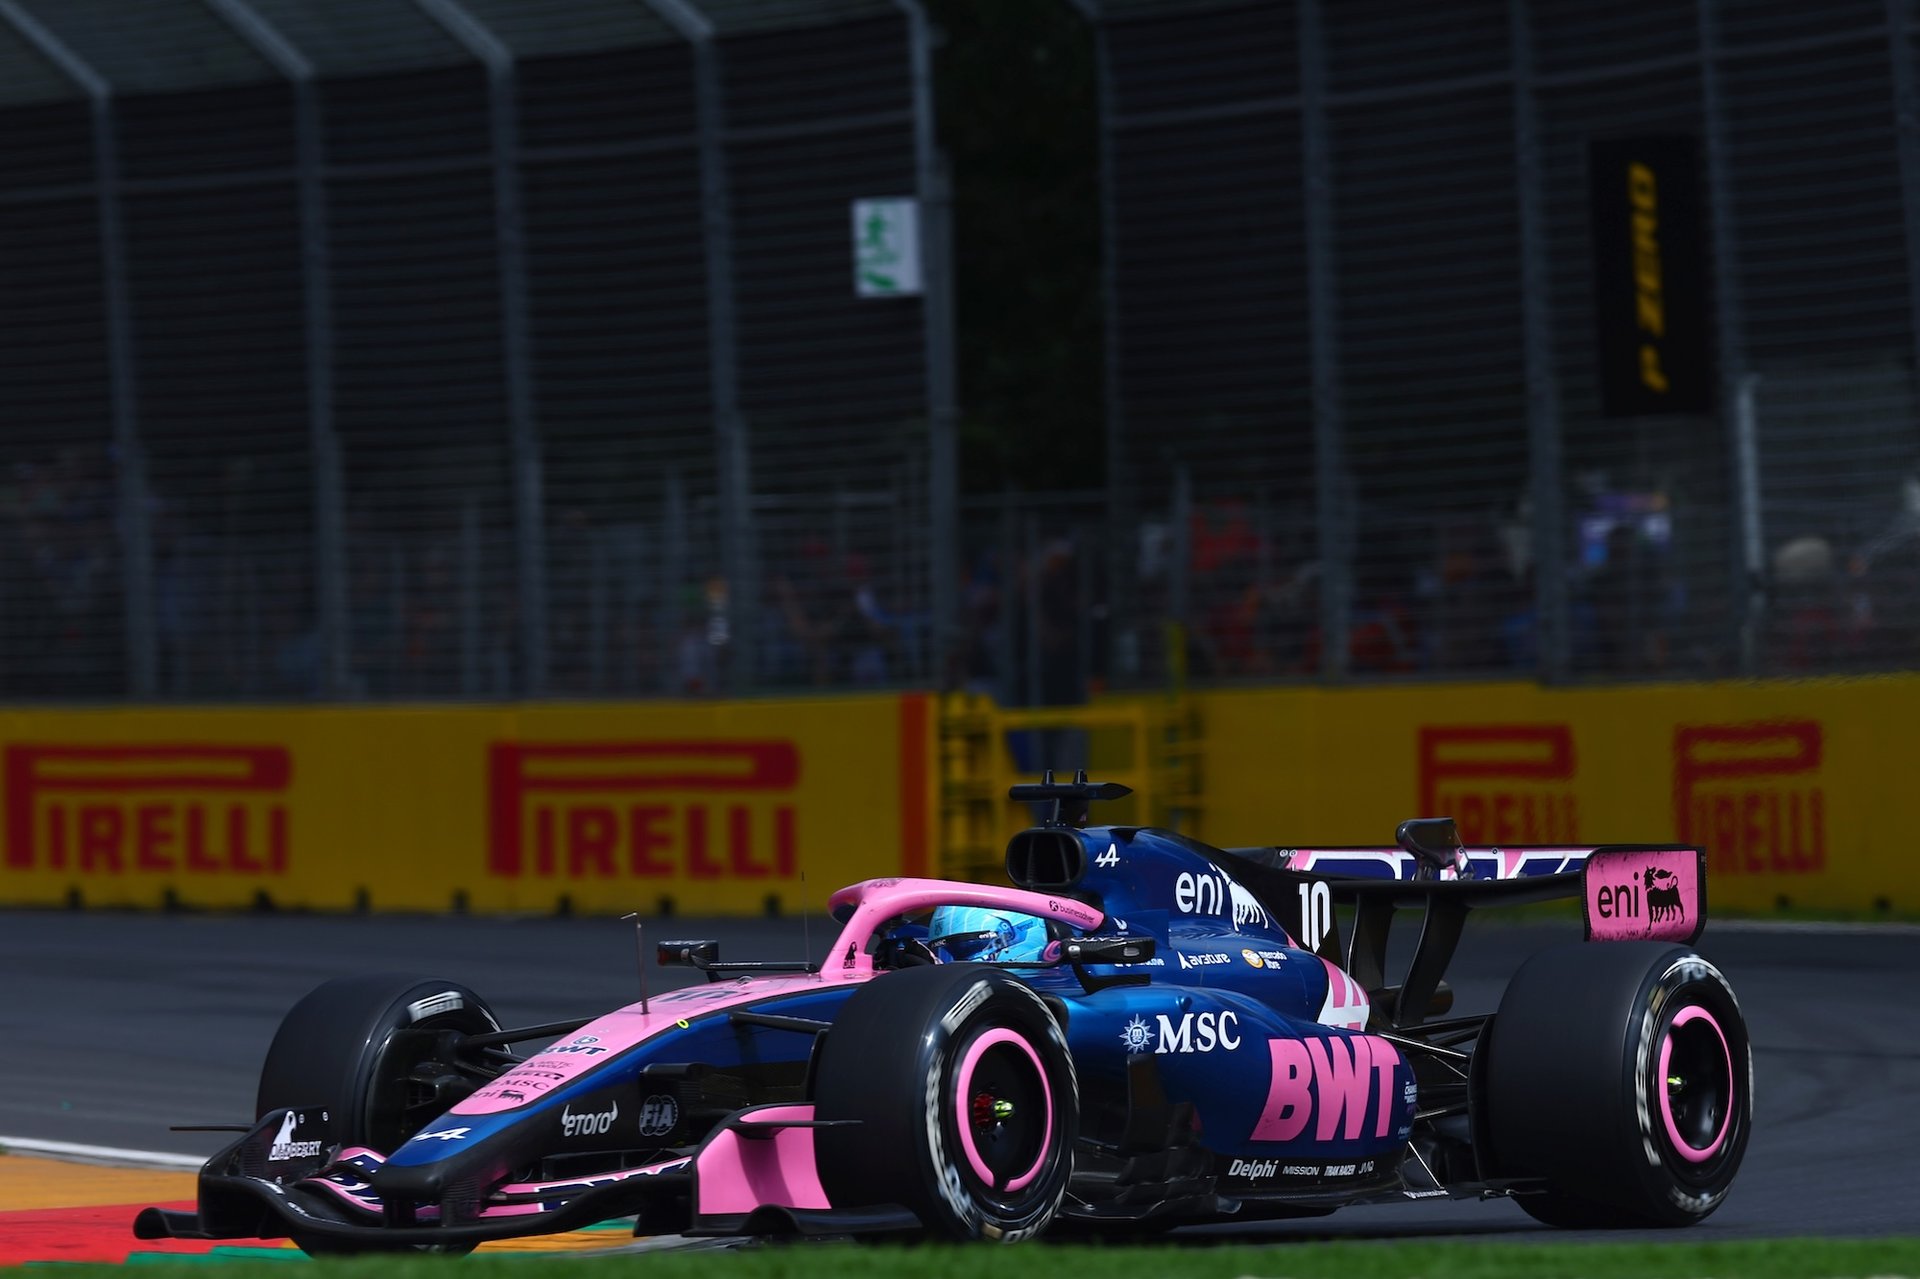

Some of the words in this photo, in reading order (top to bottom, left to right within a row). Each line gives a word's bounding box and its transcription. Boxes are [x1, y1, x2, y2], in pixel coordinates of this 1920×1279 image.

[3, 743, 291, 873] PIRELLI
[487, 740, 801, 878] PIRELLI
[1673, 719, 1825, 874] PIRELLI
[1175, 862, 1223, 916] eni
[1299, 880, 1331, 954] 10
[1598, 871, 1640, 919] eni
[1155, 1011, 1241, 1054] MSC
[1250, 1035, 1400, 1142] BWT
[1228, 1159, 1279, 1181] Delphi
[1282, 1165, 1320, 1176] MISSION
